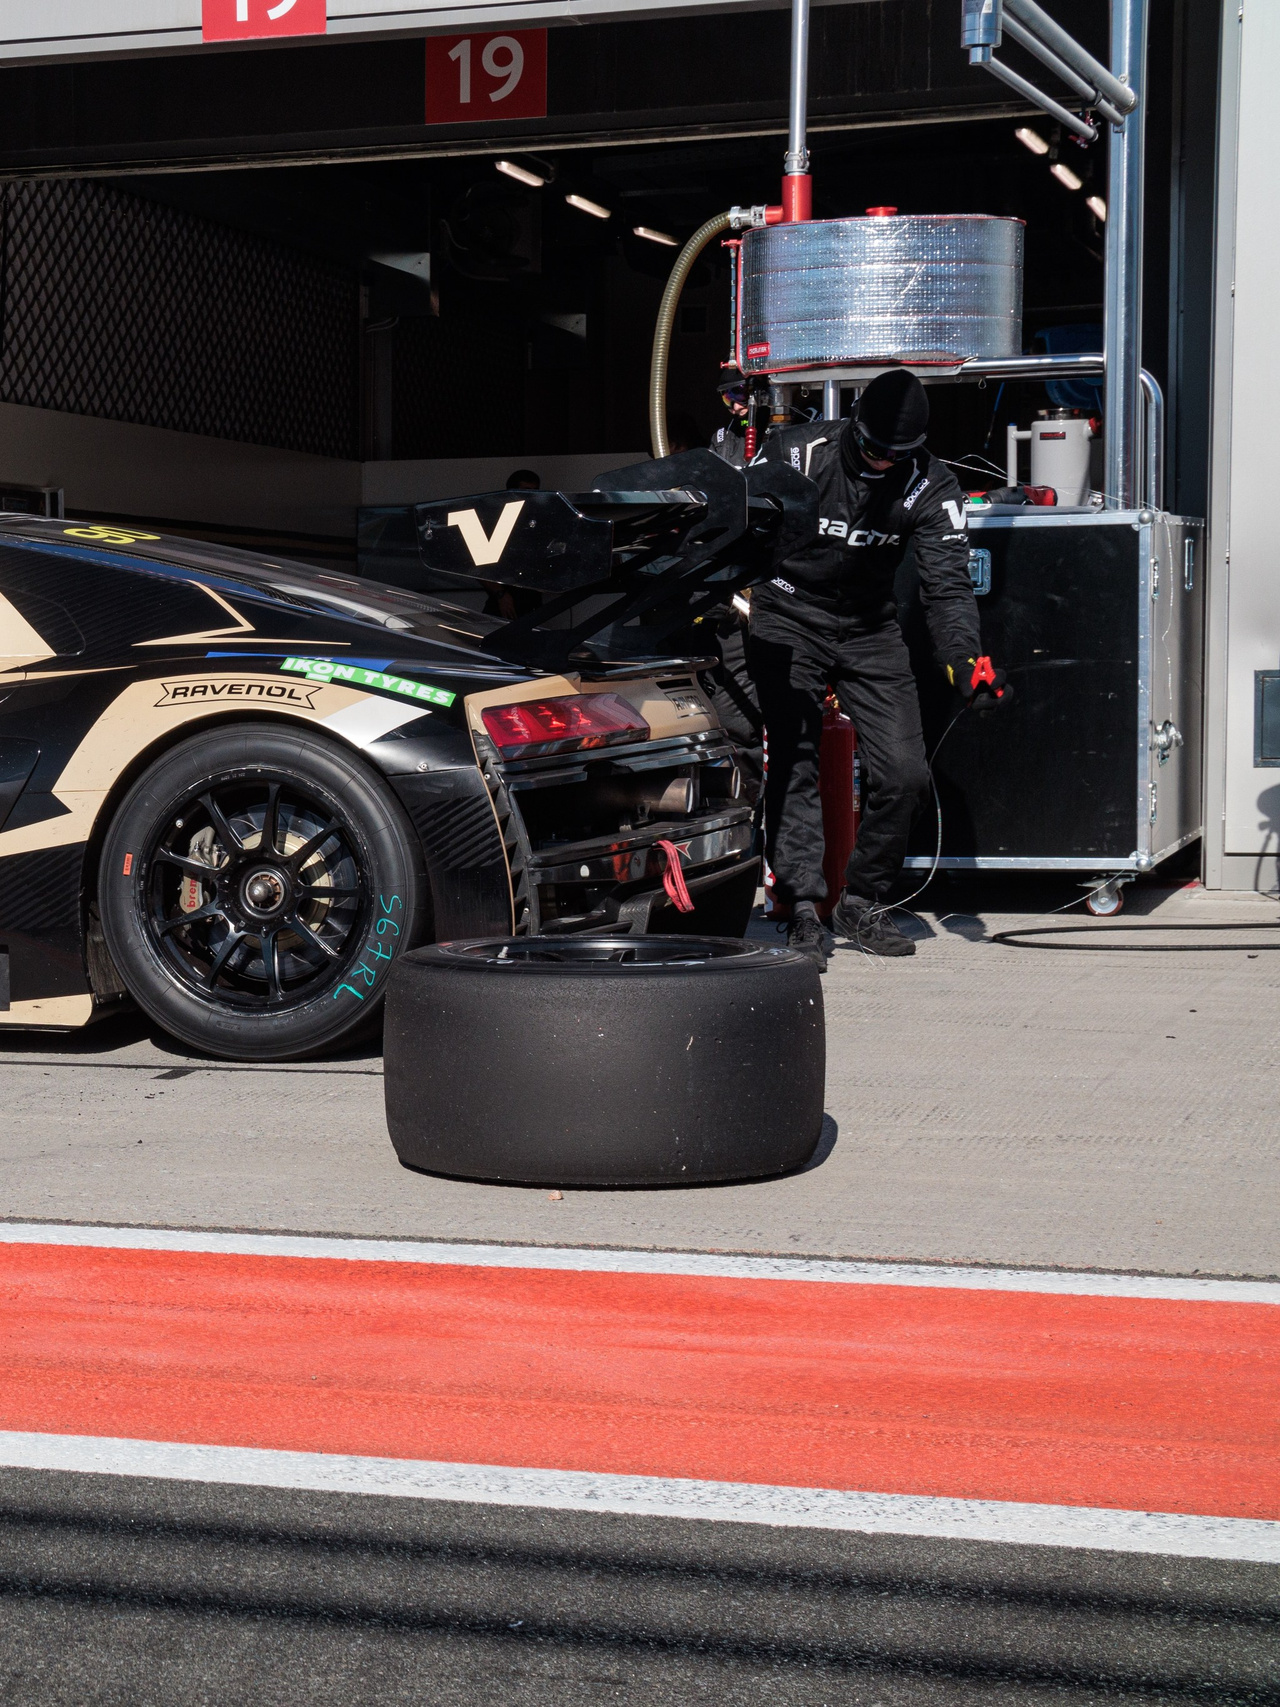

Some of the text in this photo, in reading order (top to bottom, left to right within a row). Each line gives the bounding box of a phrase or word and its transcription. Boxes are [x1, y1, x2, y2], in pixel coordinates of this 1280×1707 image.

[448, 36, 524, 103] 19
[447, 500, 525, 566] V
[171, 683, 303, 701] RAVENOL
[283, 657, 451, 705] IKON TYRES
